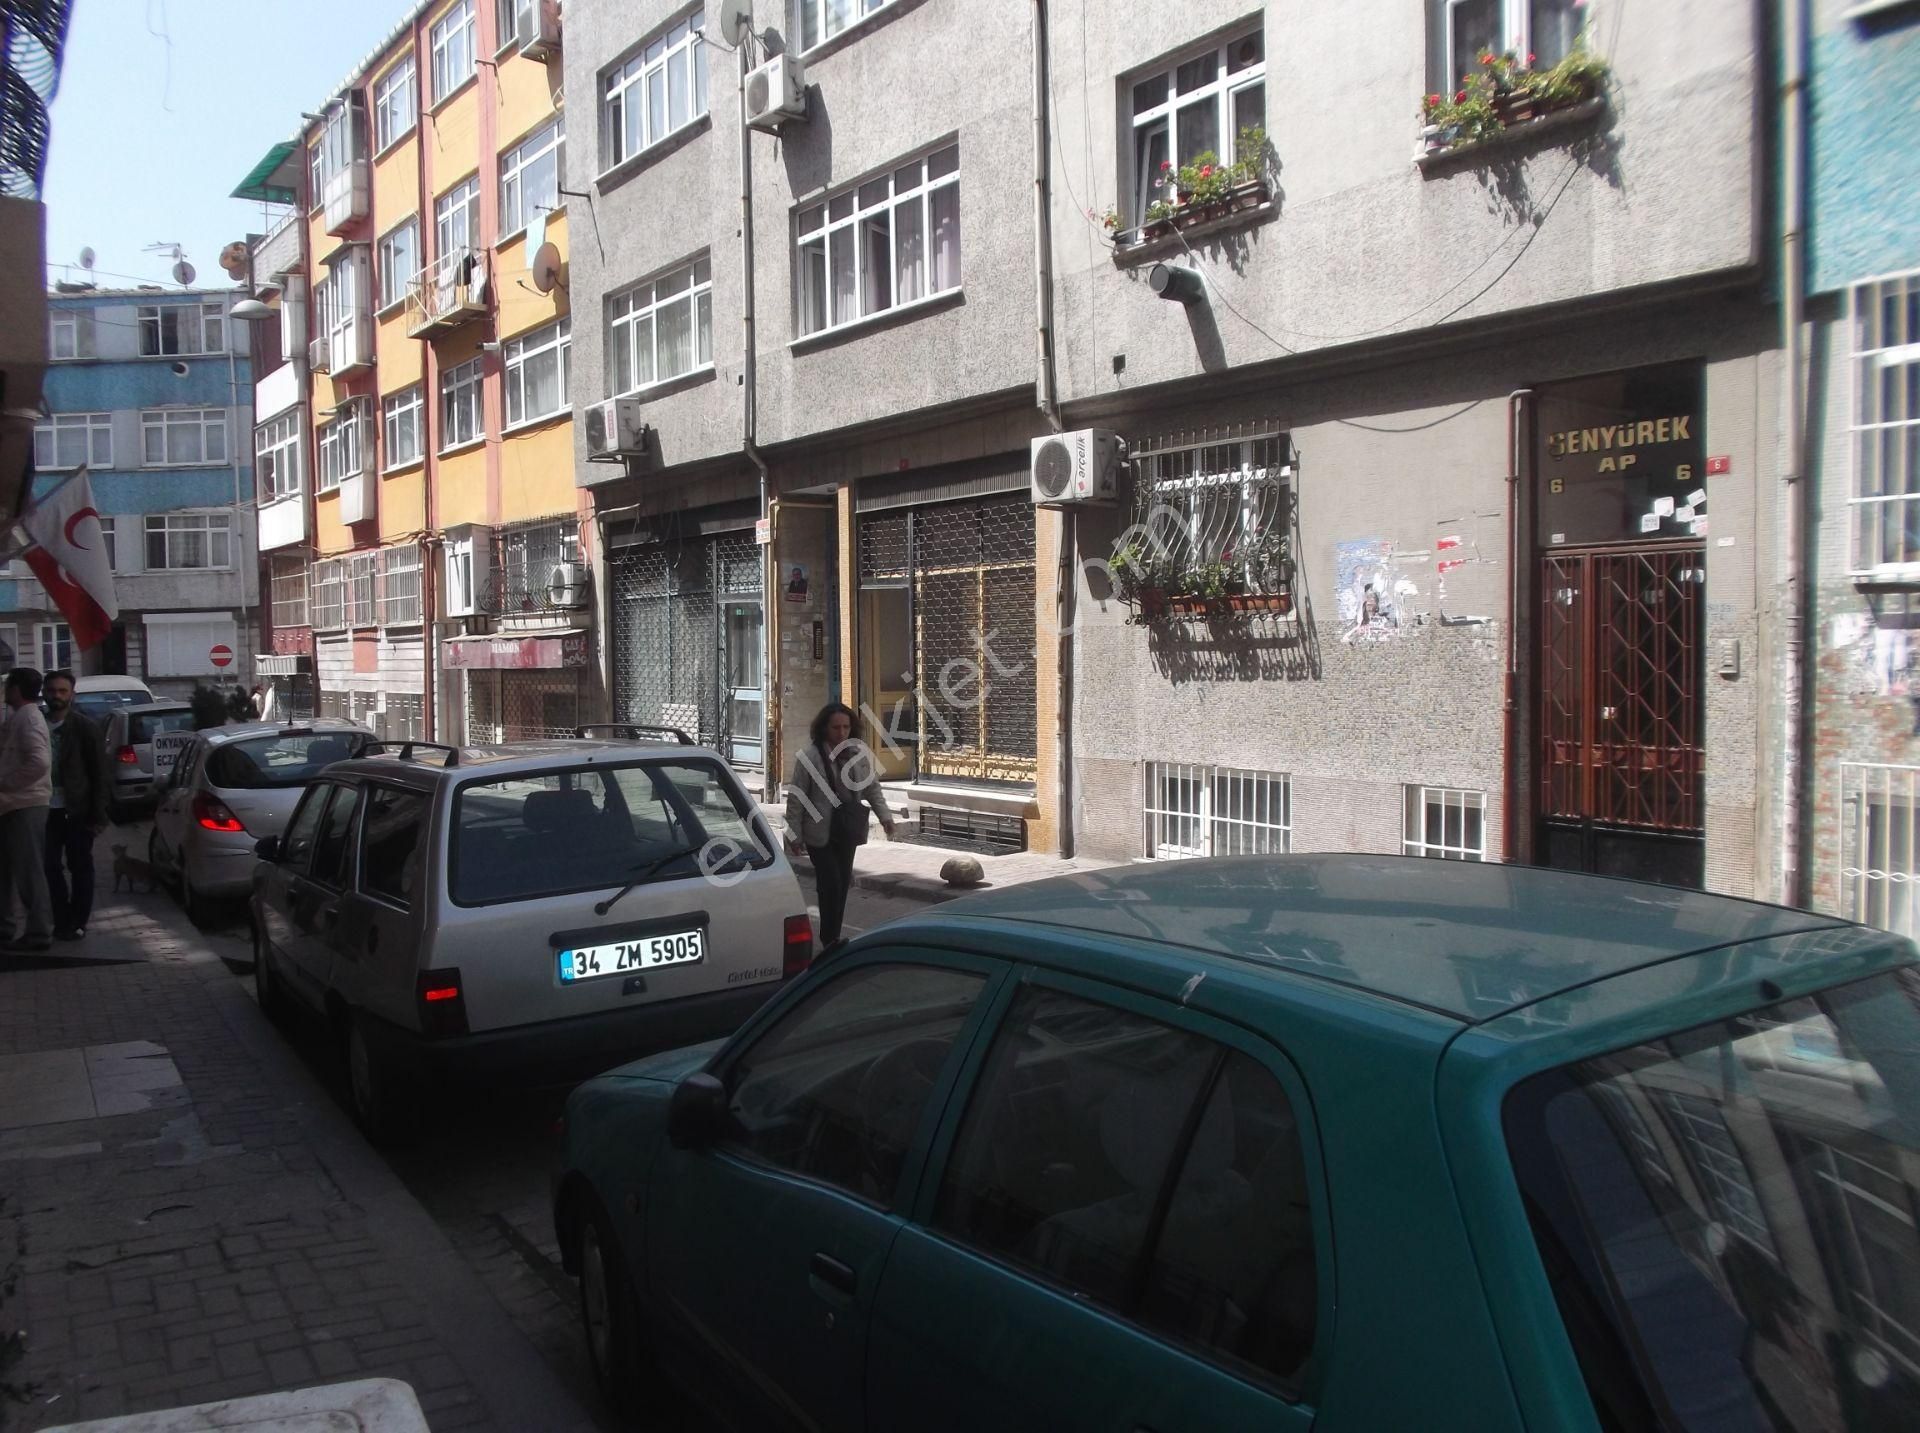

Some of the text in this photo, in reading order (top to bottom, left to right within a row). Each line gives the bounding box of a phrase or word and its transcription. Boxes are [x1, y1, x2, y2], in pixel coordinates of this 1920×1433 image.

[1598, 454, 1637, 473] AP
[1714, 459, 1721, 469] 6
[1676, 464, 1692, 480] 6
[1550, 478, 1563, 493] 6
[575, 934, 699, 976] 34 ZM 5905
[563, 967, 574, 975] TR
